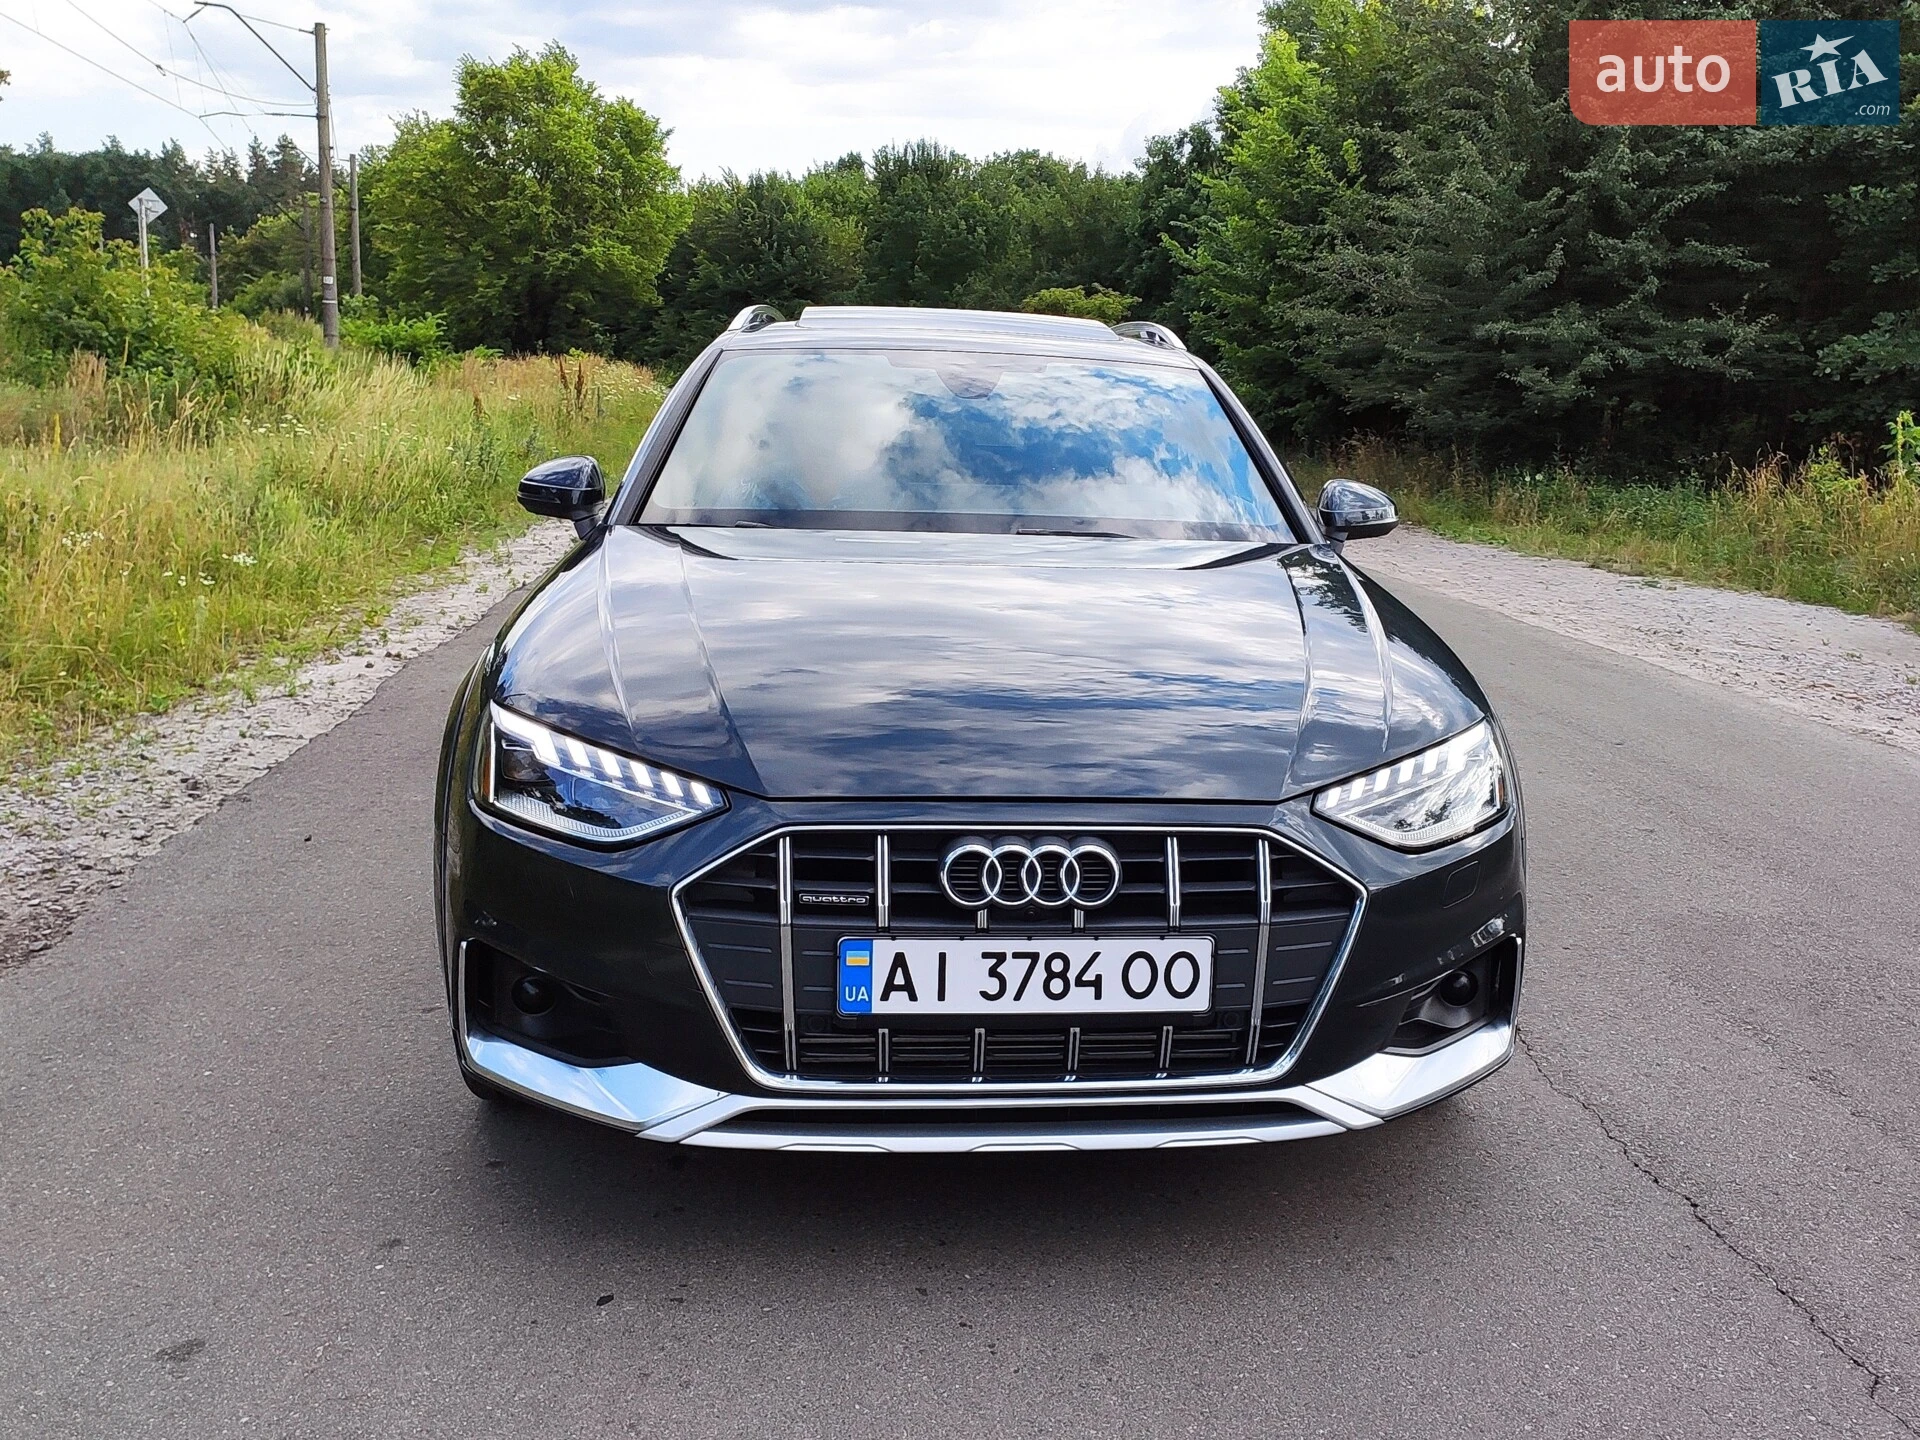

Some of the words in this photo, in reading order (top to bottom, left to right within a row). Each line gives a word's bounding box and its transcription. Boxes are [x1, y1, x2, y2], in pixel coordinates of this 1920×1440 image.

[802, 895, 866, 904] quattro
[880, 951, 947, 1002] AI
[978, 950, 1103, 1001] 3784
[1121, 950, 1201, 1000] OO
[845, 986, 869, 1002] UA
